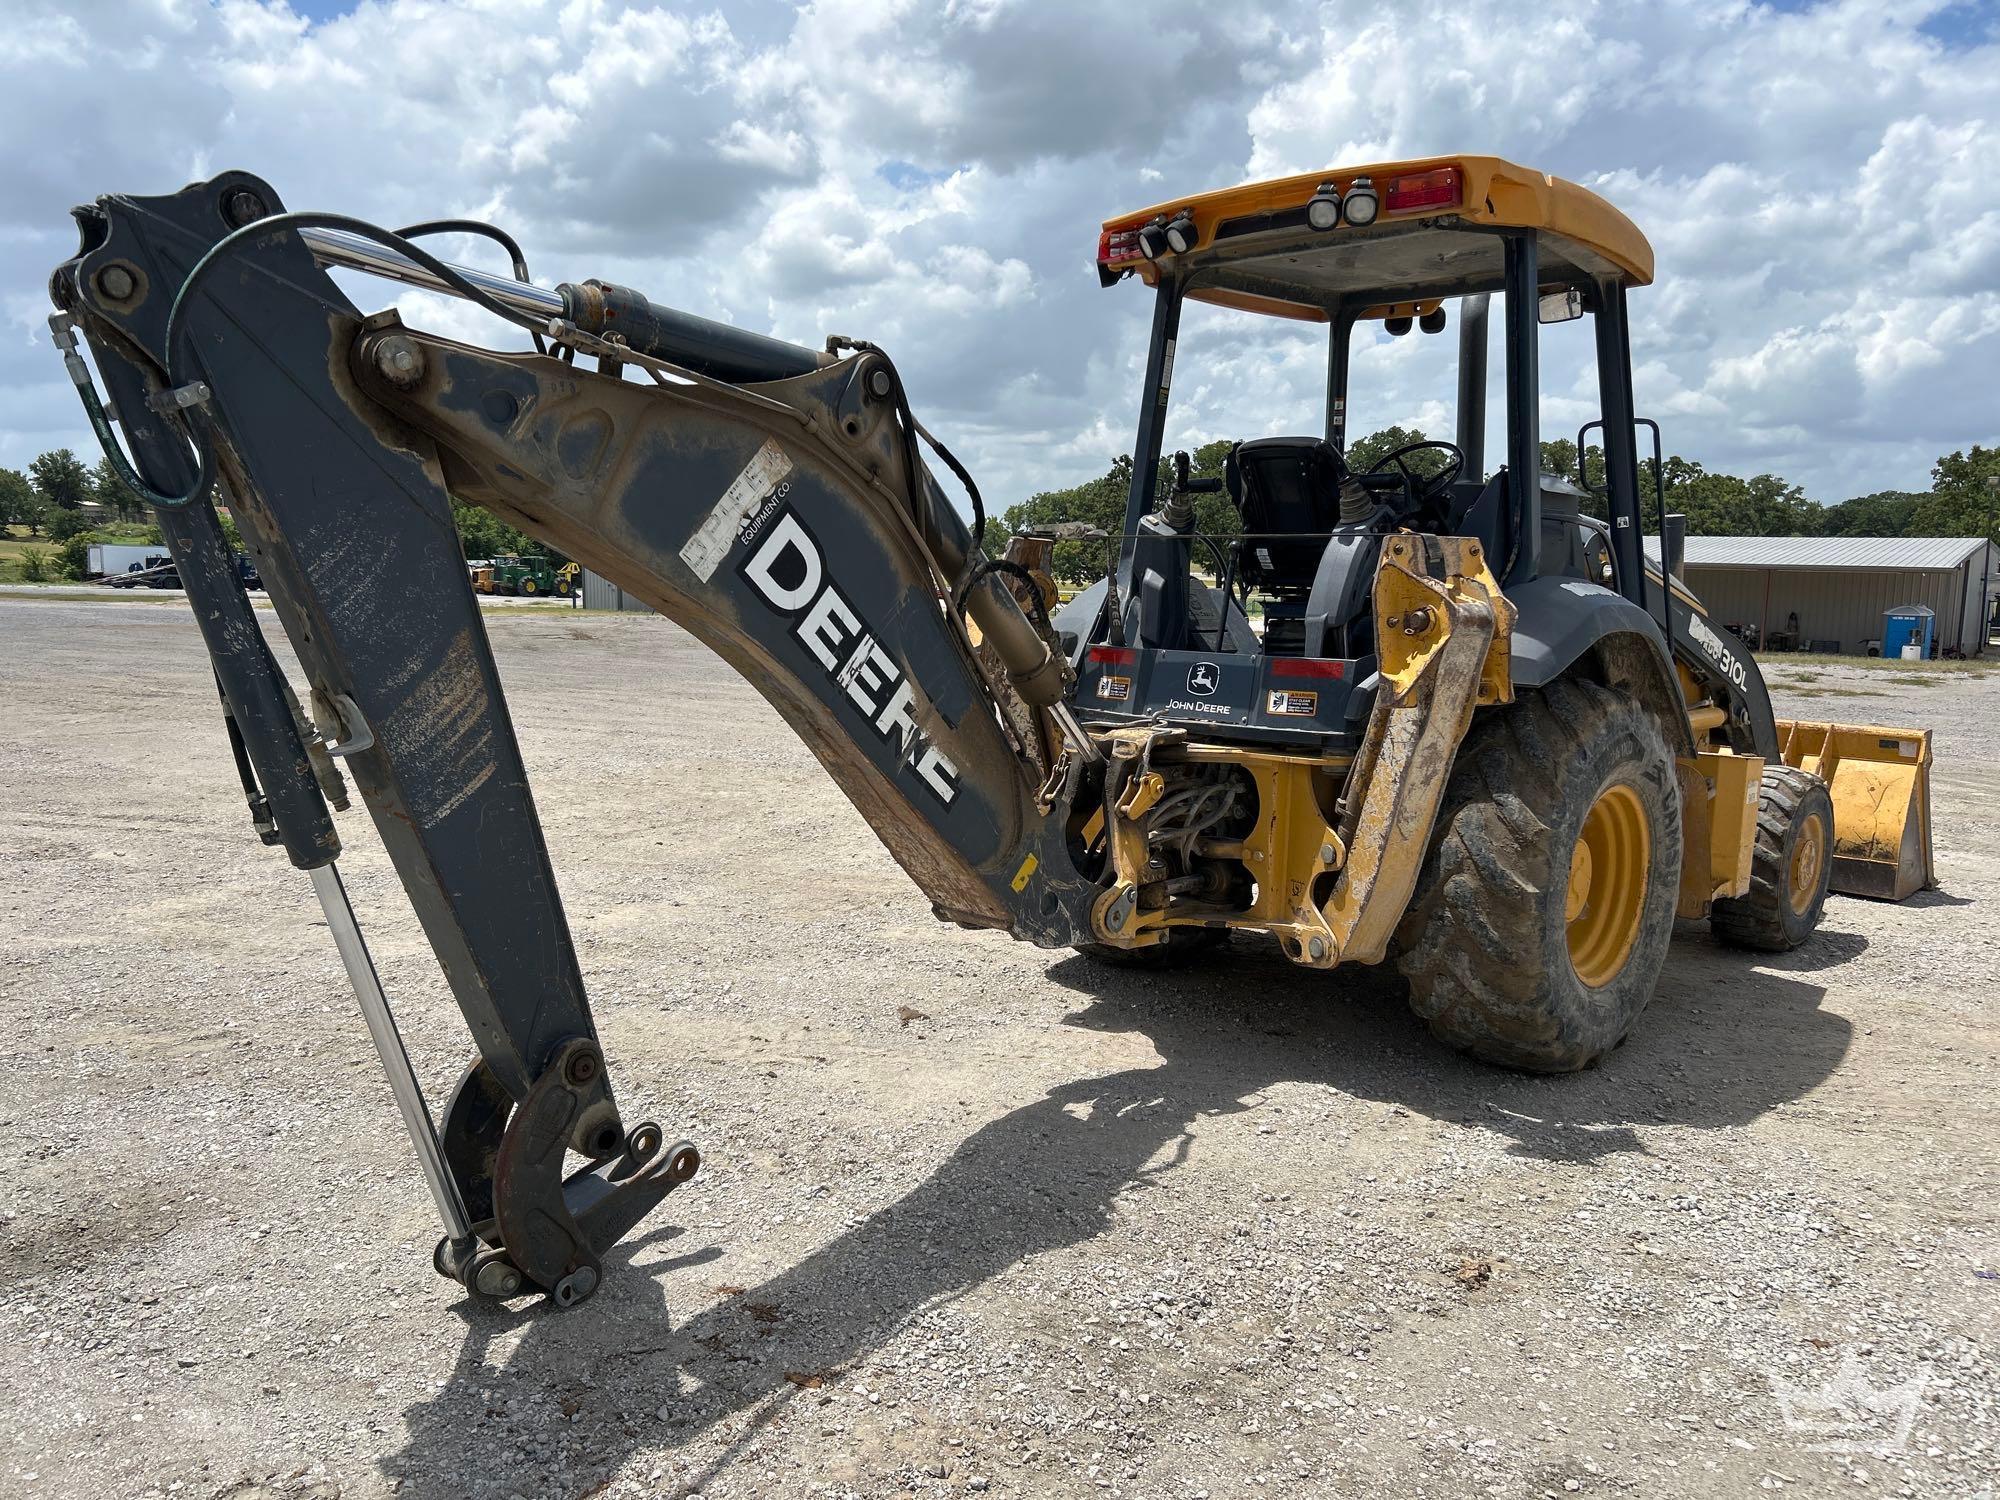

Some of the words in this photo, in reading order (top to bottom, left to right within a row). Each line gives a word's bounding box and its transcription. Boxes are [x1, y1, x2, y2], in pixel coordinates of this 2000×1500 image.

[741, 495, 780, 545] EQUIPMENT
[777, 481, 793, 498] CO.
[1719, 648, 1747, 693] 310L
[1165, 699, 1194, 710] JOHN
[1195, 701, 1231, 714] DEERE
